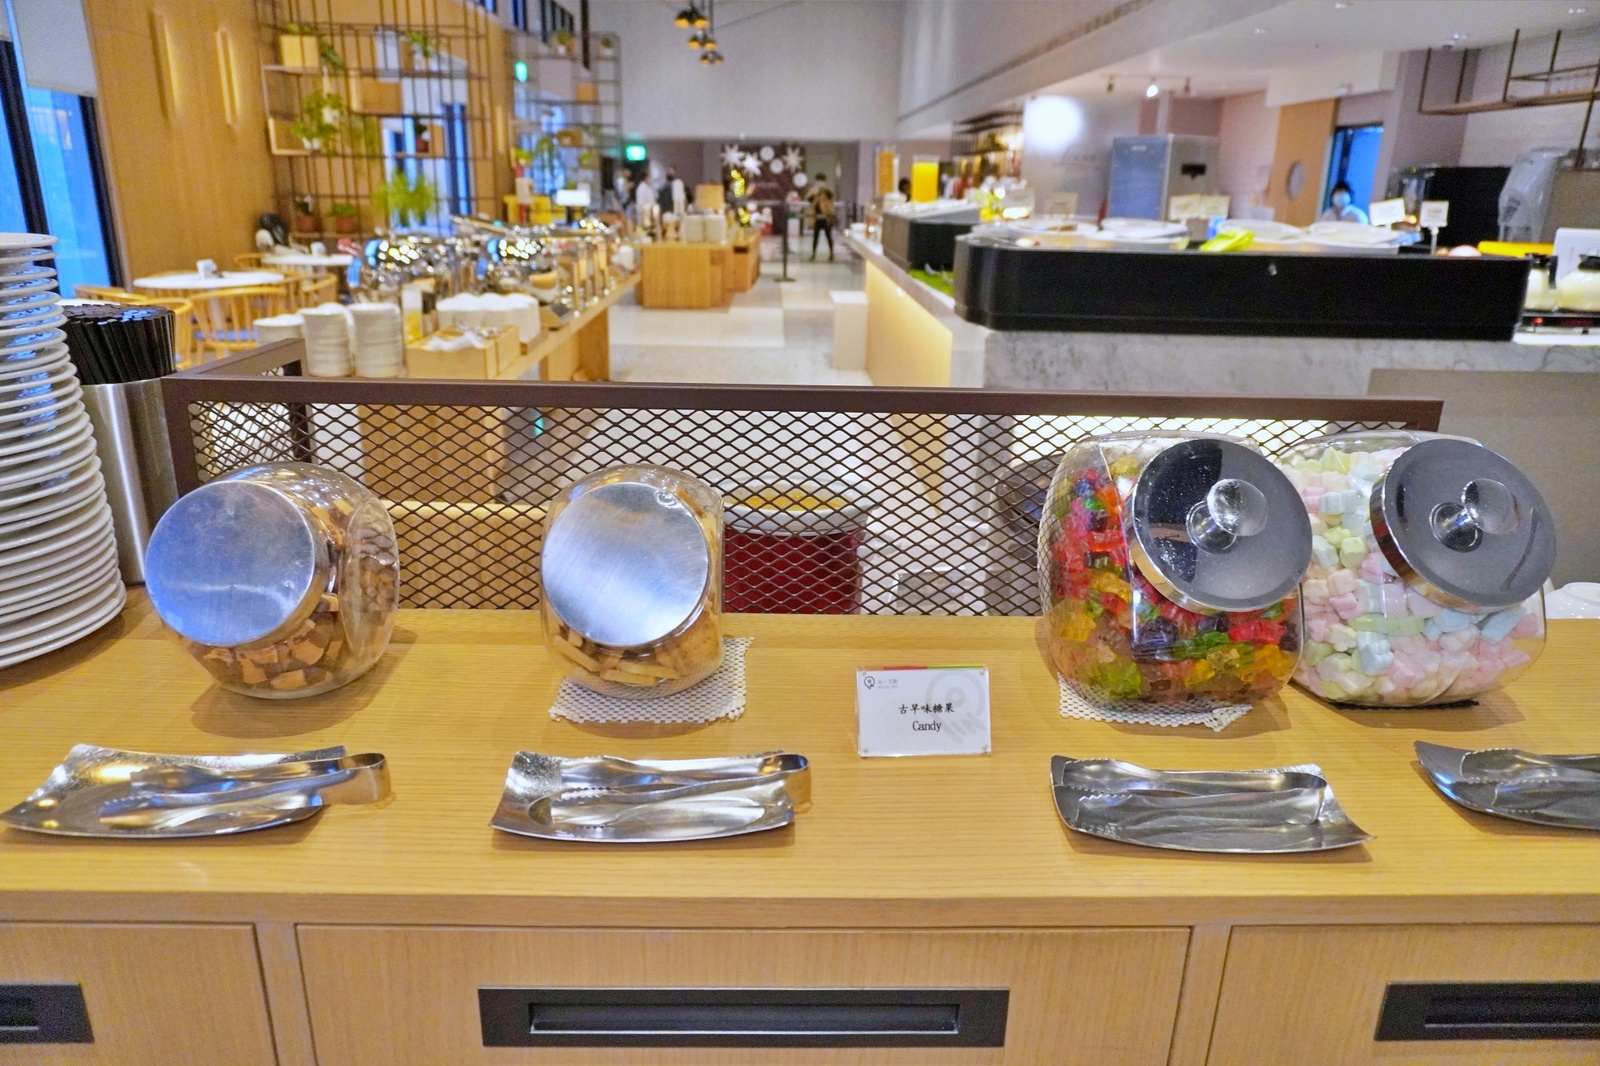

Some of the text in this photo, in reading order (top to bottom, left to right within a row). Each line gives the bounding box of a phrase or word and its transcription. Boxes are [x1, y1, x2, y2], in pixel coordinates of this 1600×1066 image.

[898, 702, 955, 715] 古早味糖果
[912, 720, 942, 732] Candy
